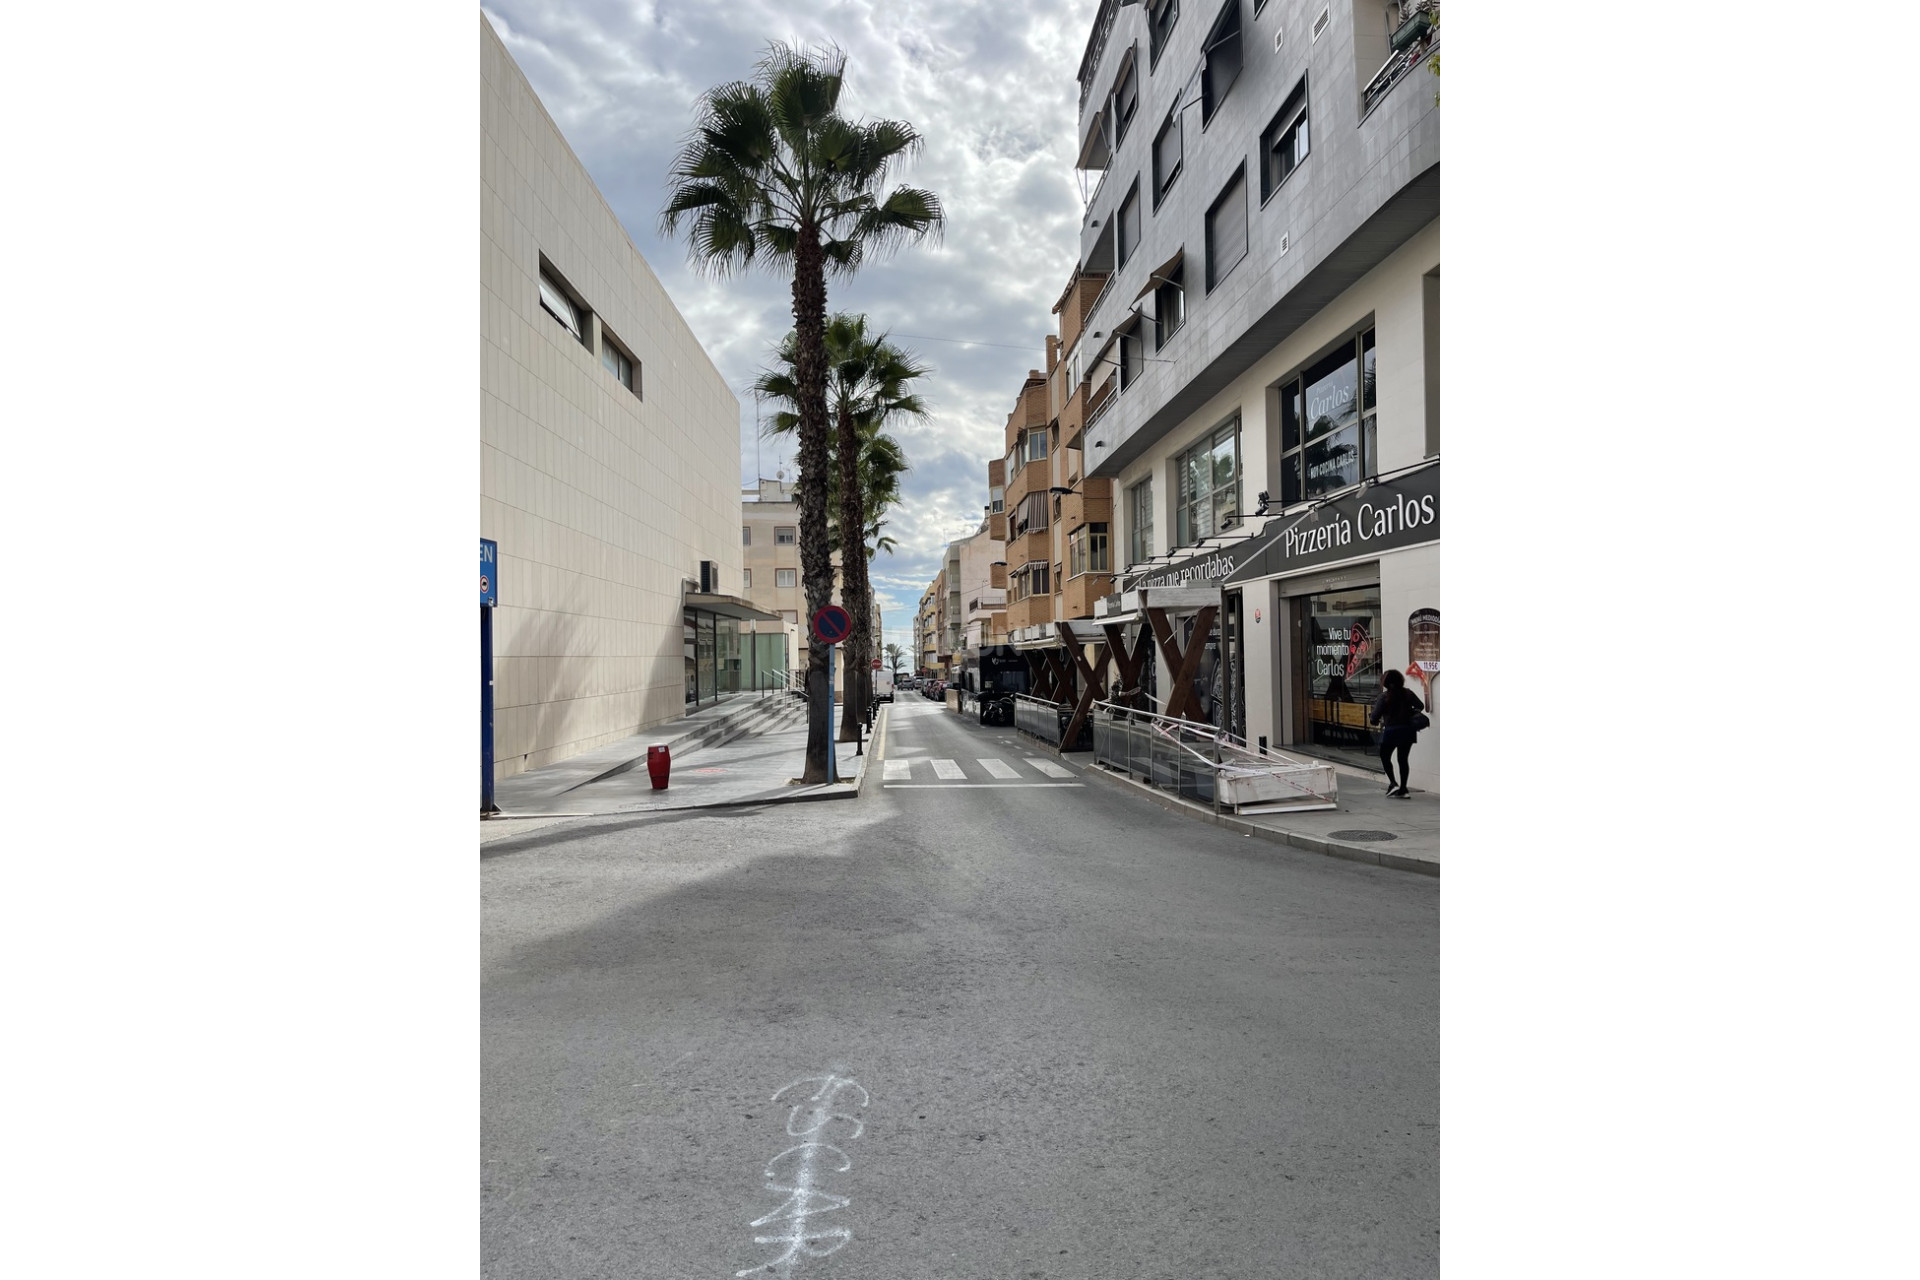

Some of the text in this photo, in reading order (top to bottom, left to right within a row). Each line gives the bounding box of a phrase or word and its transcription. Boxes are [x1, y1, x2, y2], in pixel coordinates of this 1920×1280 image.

[1310, 385, 1349, 419] Carlos
[1285, 493, 1436, 558] Pizzería Carlos
[1180, 553, 1234, 581] recordabas
[1328, 627, 1351, 640] Vive tu
[1316, 642, 1350, 656] momento
[1316, 658, 1345, 677] Carlos
